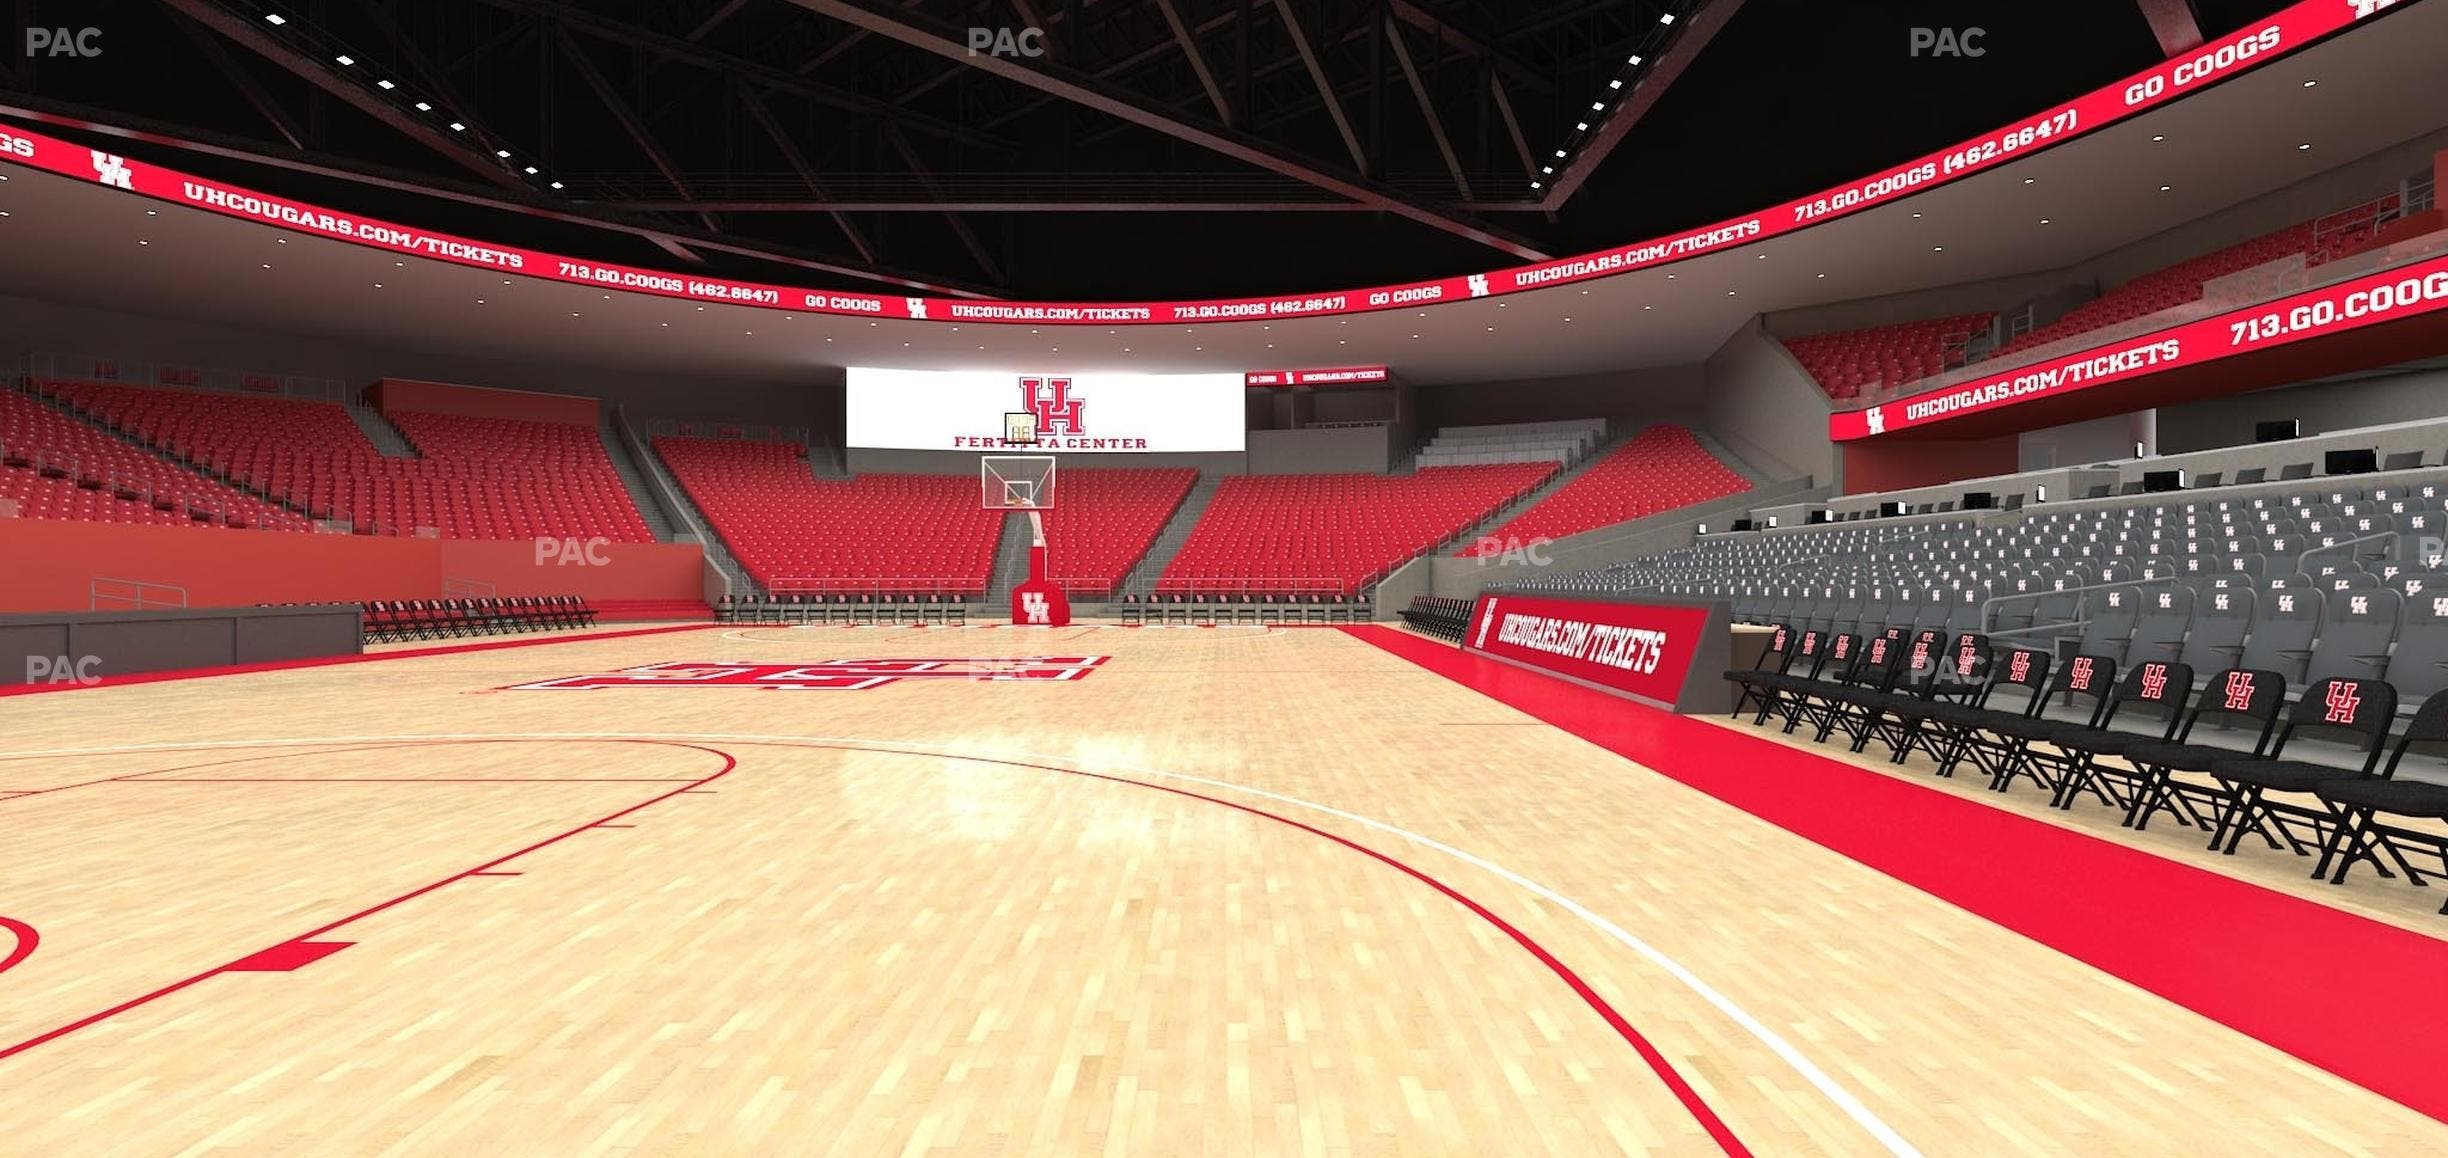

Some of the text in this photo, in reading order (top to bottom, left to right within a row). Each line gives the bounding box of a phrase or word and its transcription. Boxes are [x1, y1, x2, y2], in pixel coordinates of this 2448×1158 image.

[2125, 25, 2281, 106] GO COOGS
[1794, 108, 2077, 222] 713.GO.COOGS (462.6647)
[183, 181, 523, 268] UHCOUGARS.COM/TICKETS
[1515, 219, 1761, 287] UHCOUGARS.COM/TICKETS
[559, 261, 779, 304] 713.GO.COOGS (462.6647)
[806, 295, 881, 312] GO COOGS
[1369, 285, 1442, 306] GO COOGS
[951, 304, 1151, 320] UHCOUGARS.COM/TICKETS
[1173, 302, 1267, 318] 713.GO.COOGS
[2231, 271, 2448, 346] 713.GO.COOG
[1906, 338, 2180, 422] UHCOUGARS.COM/TICKETS
[1019, 377, 1085, 436] UH
[1066, 438, 1148, 449] CENTER
[1498, 612, 1667, 675] UHCOUGARS.COM/TICKETS
[2141, 663, 2167, 699] UH
[2224, 671, 2255, 711] UH
[2324, 680, 2360, 724] UH
